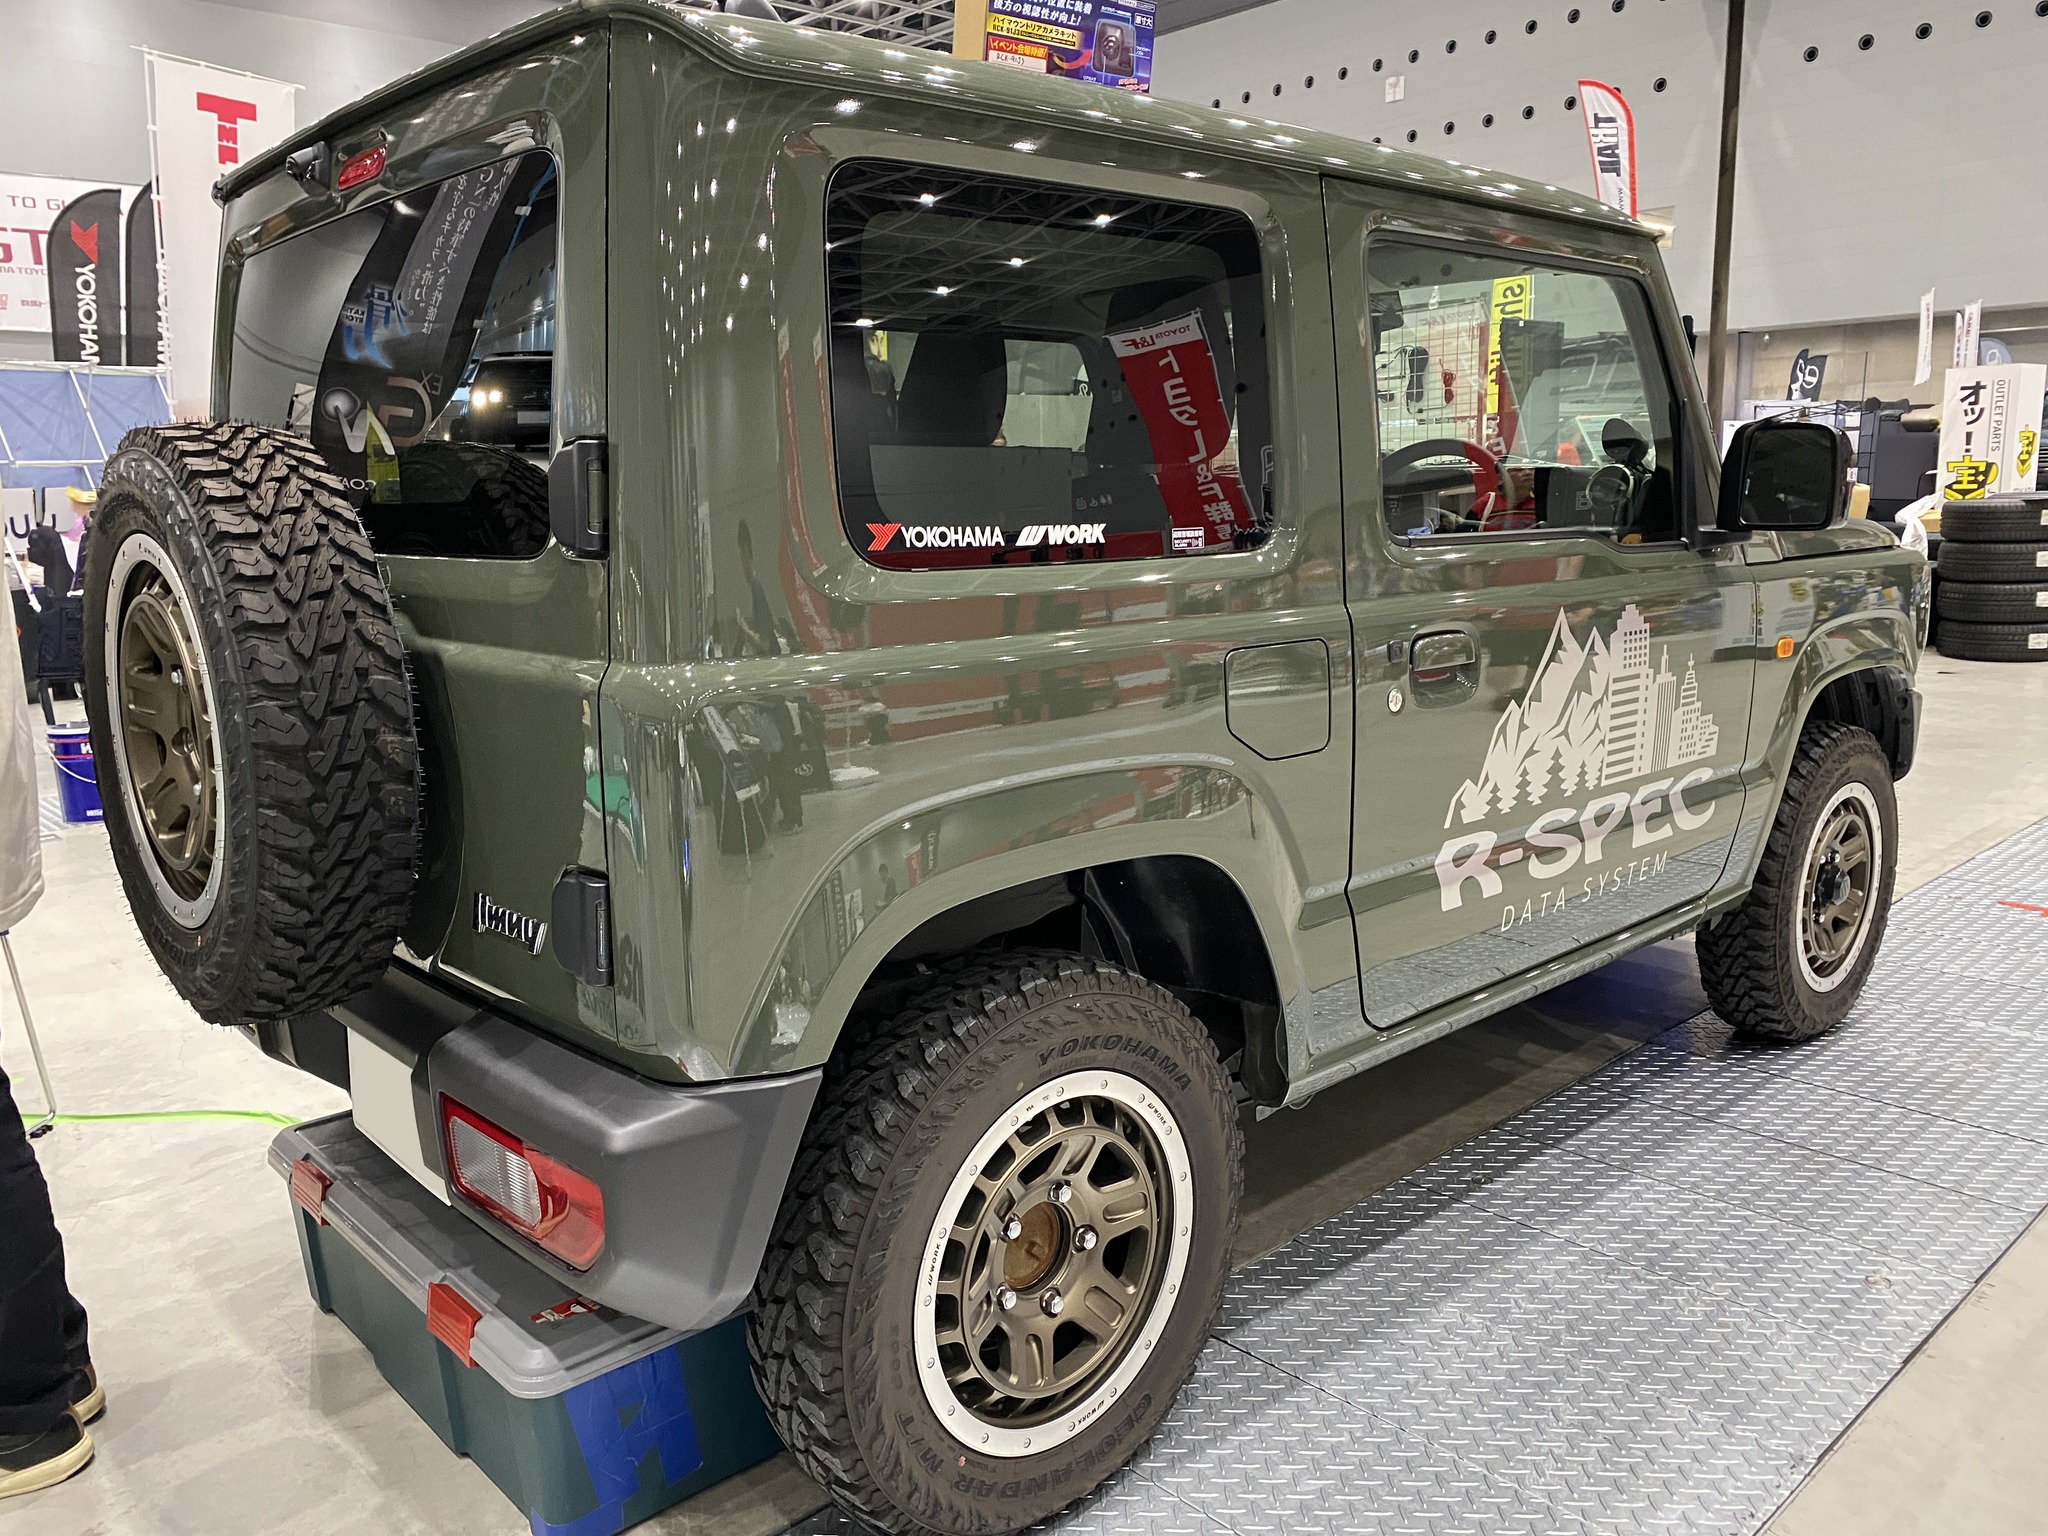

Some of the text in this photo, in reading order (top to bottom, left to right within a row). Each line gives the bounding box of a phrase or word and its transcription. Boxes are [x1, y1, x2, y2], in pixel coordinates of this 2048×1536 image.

[7, 195, 36, 208] TO
[74, 263, 101, 364] YOKOHAM
[1991, 379, 2006, 452] OUTLET PARTS
[901, 526, 1005, 548] YOKOHAMA
[1047, 523, 1107, 545] WORK
[1434, 767, 1716, 912] R-SPEC
[1501, 850, 1668, 932] DATA SYSTEM
[1038, 1034, 1193, 1092] YOKOHAMA
